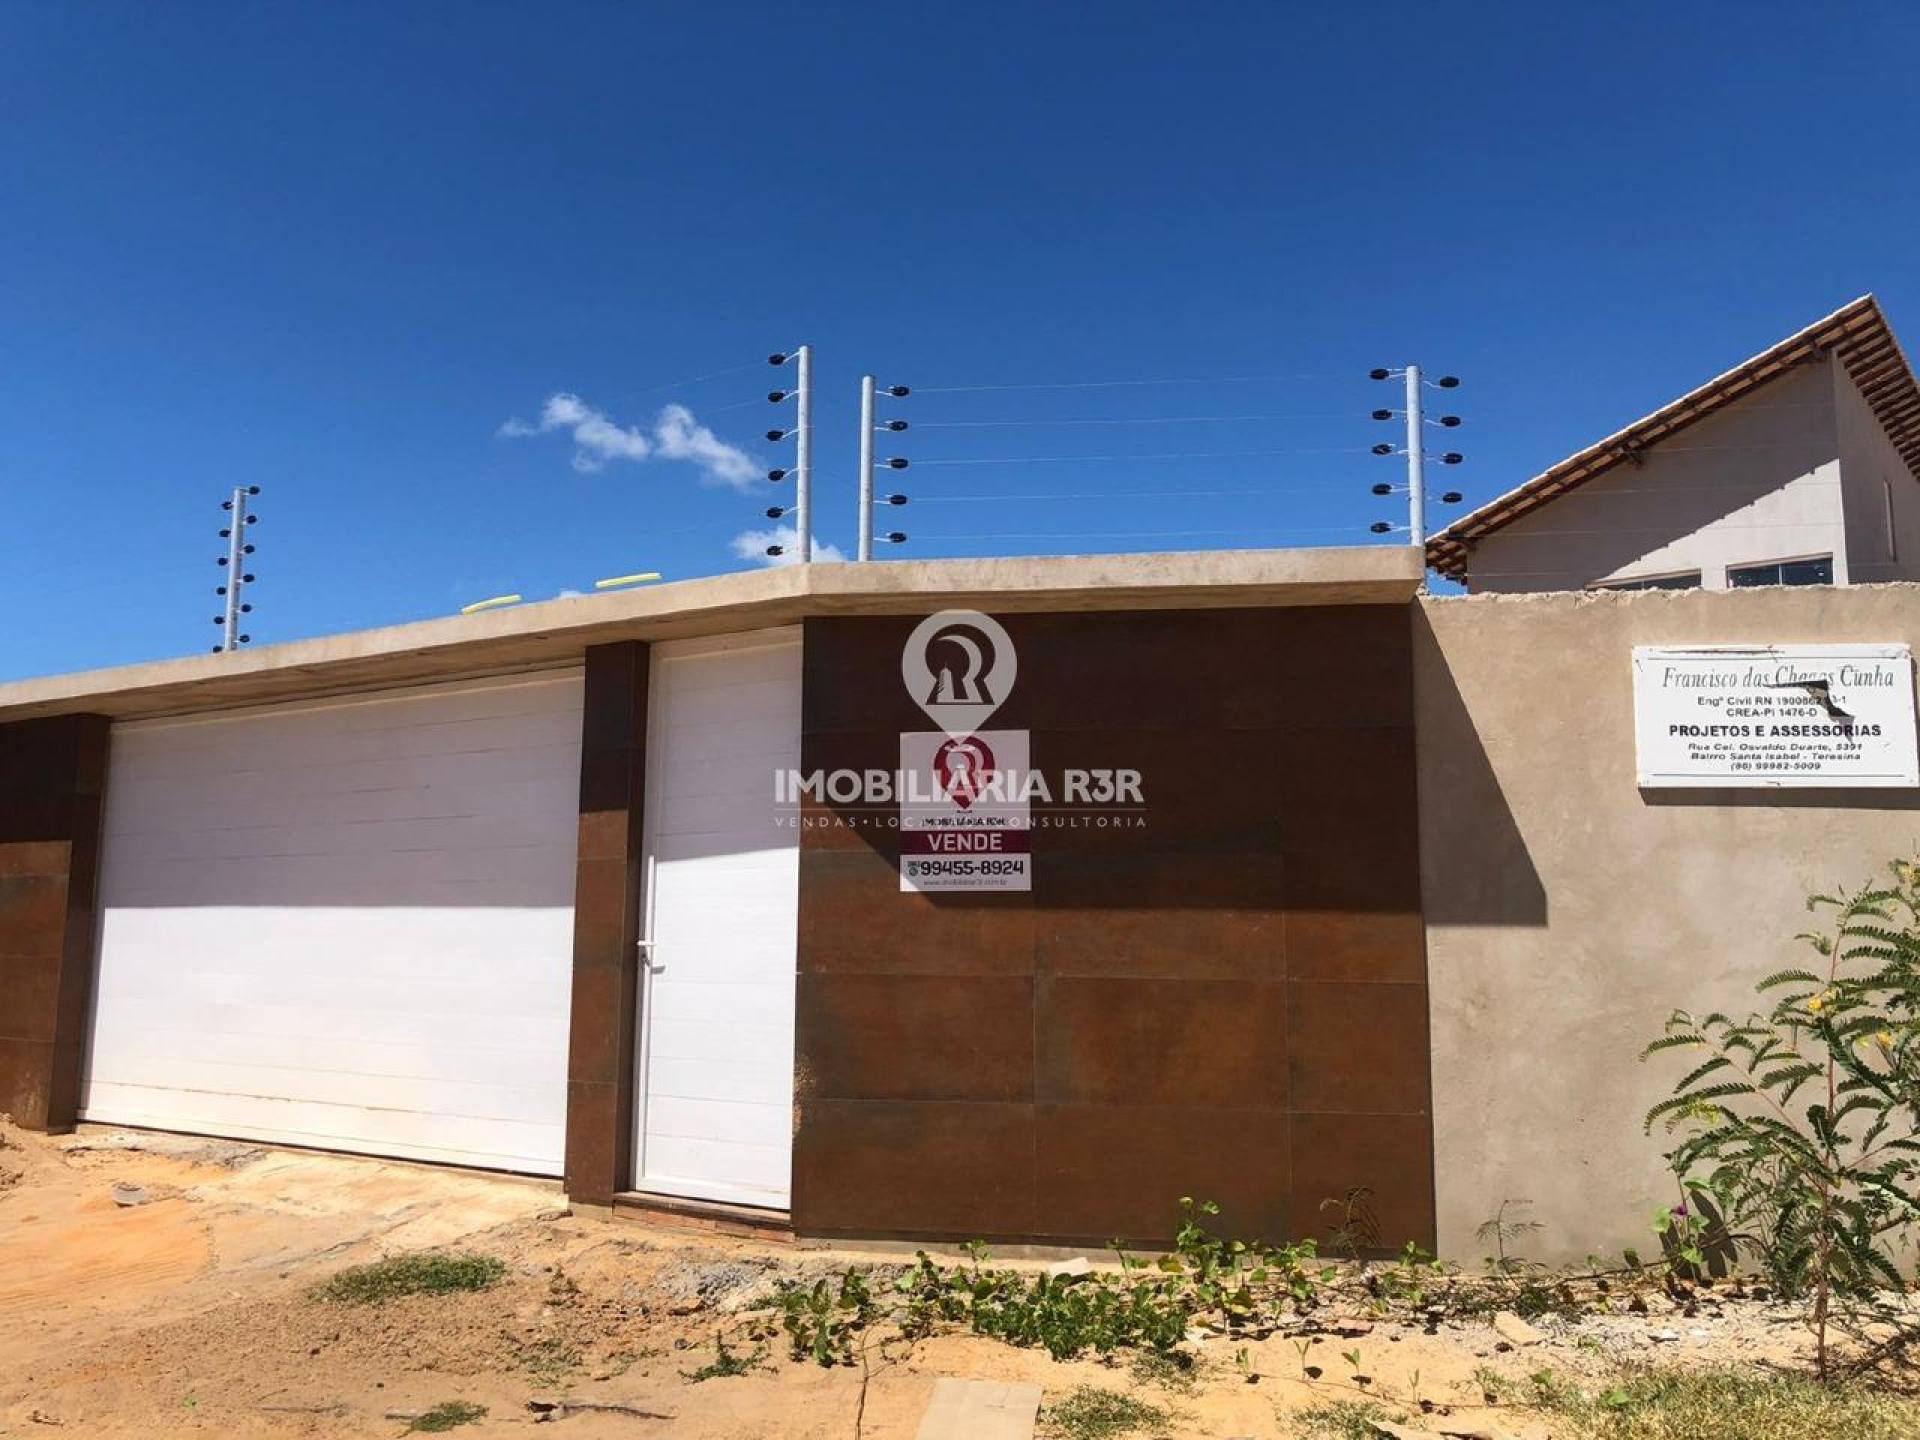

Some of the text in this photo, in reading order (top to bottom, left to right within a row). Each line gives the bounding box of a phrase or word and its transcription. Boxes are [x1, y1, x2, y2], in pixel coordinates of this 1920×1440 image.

[1663, 666, 1738, 688] Francisco
[1743, 666, 1771, 688] das
[1840, 664, 1894, 687] Cunha
[1727, 696, 1752, 706] Civil
[1755, 696, 1772, 706] RN
[1669, 724, 1882, 737] PROJETOS E ASSESSORIAS
[1688, 743, 1710, 751] Rua
[1739, 743, 1786, 751] Osvaldo
[1730, 752, 1762, 760] Santa
[1765, 752, 1800, 760] Isabel
[1812, 752, 1861, 760] Teresina
[927, 832, 1003, 852] VENDE
[920, 860, 1024, 876] 99455-8924
